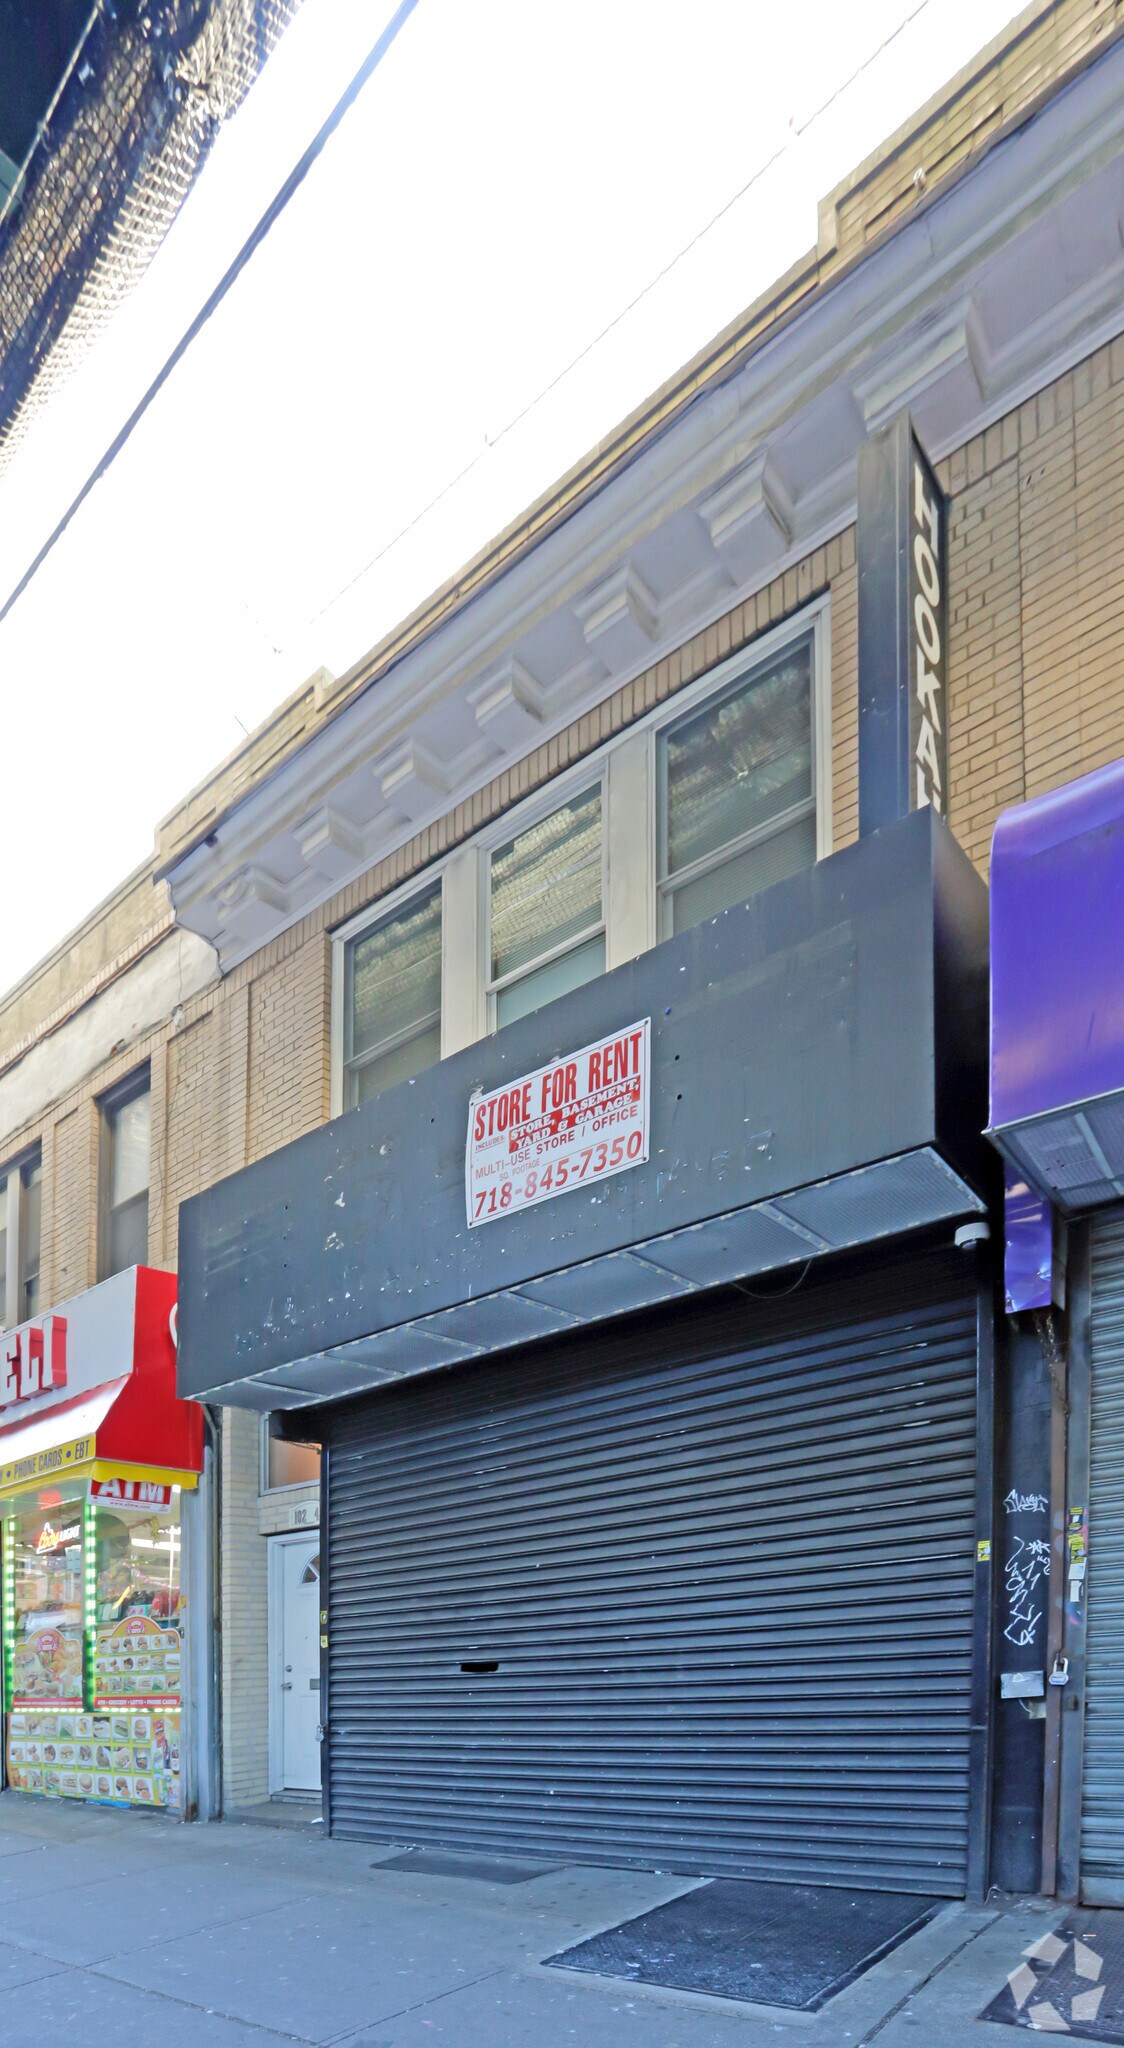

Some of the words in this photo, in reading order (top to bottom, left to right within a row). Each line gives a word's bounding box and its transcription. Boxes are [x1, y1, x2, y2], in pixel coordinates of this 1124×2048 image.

[475, 1082, 532, 1141] STORE
[541, 1062, 577, 1114] FOR
[588, 1031, 642, 1093] RENT
[510, 1112, 556, 1140] STORE,
[561, 1078, 640, 1117] BASEMENT,
[475, 1151, 531, 1180] MULTI-USE
[536, 1130, 576, 1155] STORE
[592, 1105, 638, 1132] OFFICE
[514, 1127, 551, 1150] YARD
[558, 1119, 569, 1131] &
[575, 1093, 633, 1125] GARAGE
[475, 1130, 642, 1218] 718-845-7350
[512, 1158, 540, 1176] FOOTAGE
[14, 1457, 37, 1480] PHONE
[38, 1448, 63, 1472] CARDS
[74, 1440, 90, 1460] EBT
[294, 1509, 306, 1524] 102
